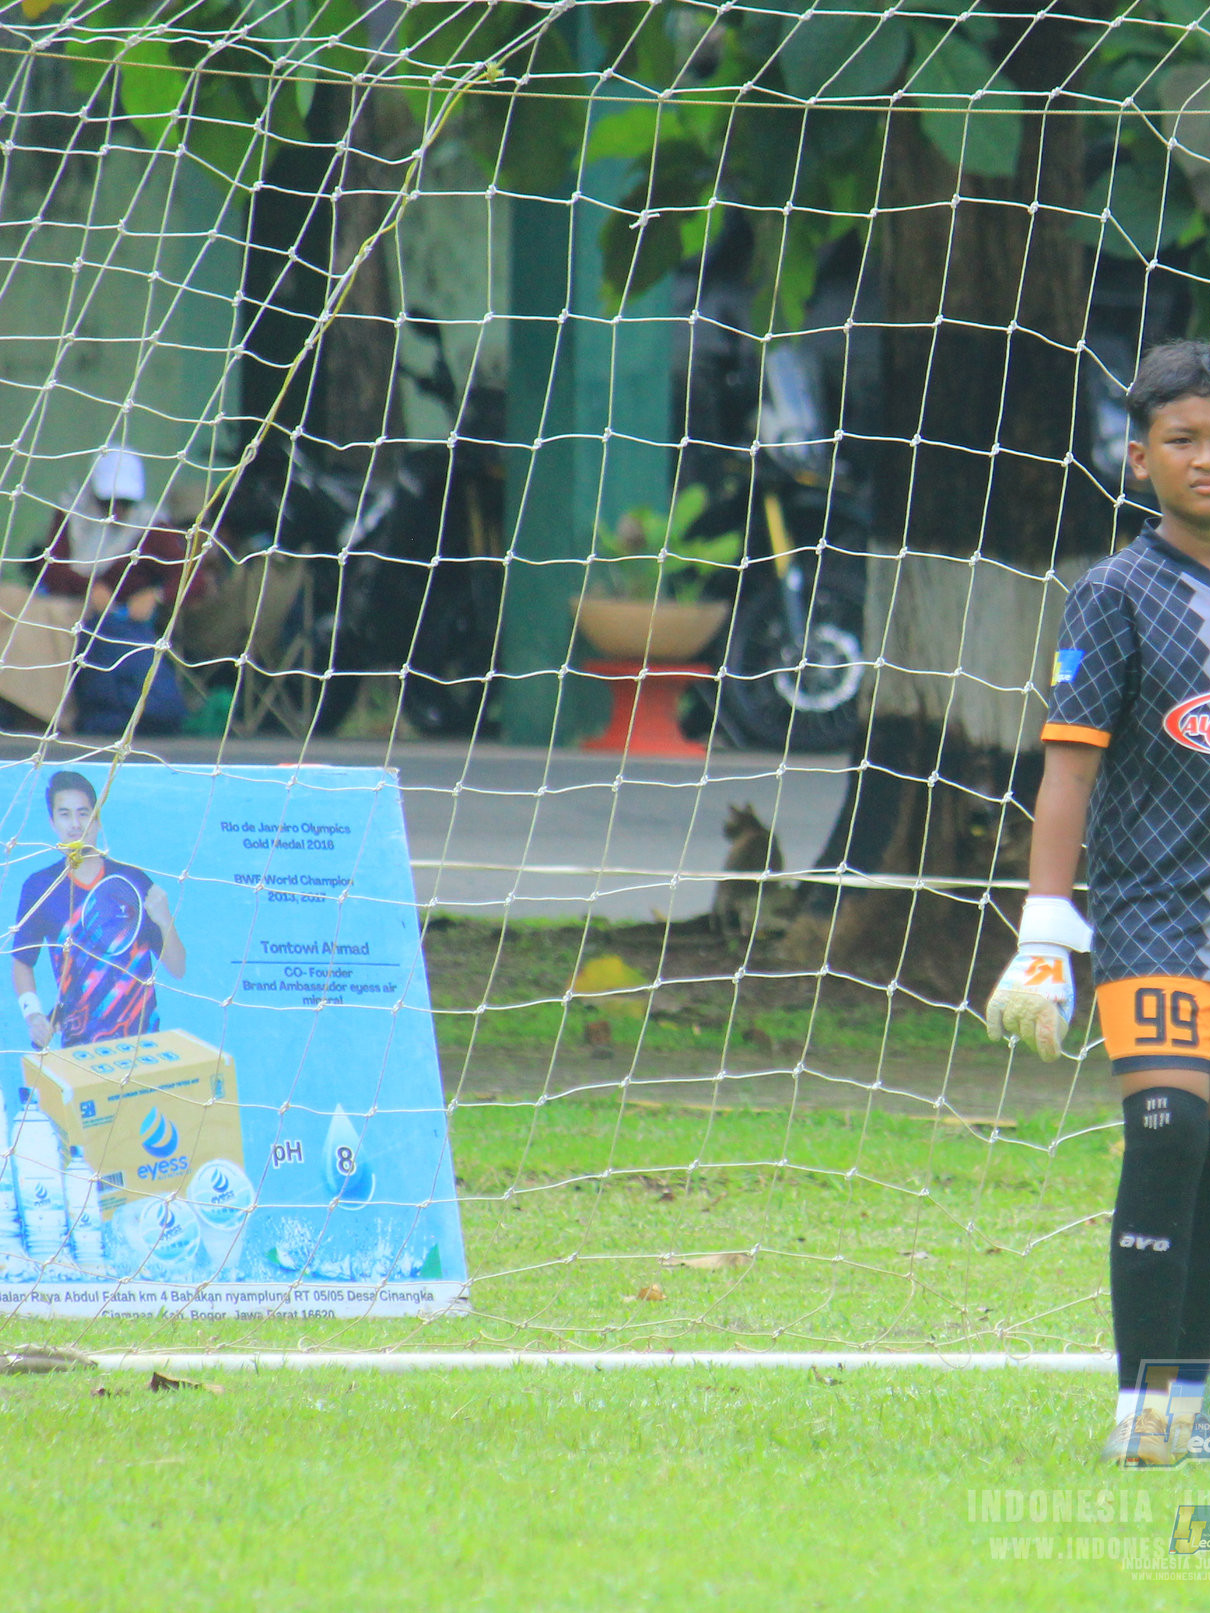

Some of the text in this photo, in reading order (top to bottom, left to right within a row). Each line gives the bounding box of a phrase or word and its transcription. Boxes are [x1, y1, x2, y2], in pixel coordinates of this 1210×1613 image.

[220, 821, 351, 836] Rio de Janeiro Olympics
[243, 838, 269, 850] Gold
[271, 839, 305, 850] Medal
[234, 874, 354, 888] BWF World Champion
[260, 940, 370, 956] Tontowi Ahmad
[309, 967, 353, 979] Founder
[242, 980, 397, 995] Brand Ambassador eyess air
[1134, 987, 1200, 1049] 99
[272, 1140, 303, 1168] pH
[337, 1146, 356, 1175] 8
[137, 1155, 189, 1182] eyess
[65, 1290, 99, 1303] Abdul
[103, 1290, 135, 1303] Fatah
[138, 1290, 157, 1303] km
[160, 1290, 168, 1303] 4
[294, 1290, 310, 1302] RT
[313, 1290, 345, 1302] 05/05
[347, 1290, 377, 1302] Desa
[379, 1290, 434, 1305] Cinangka
